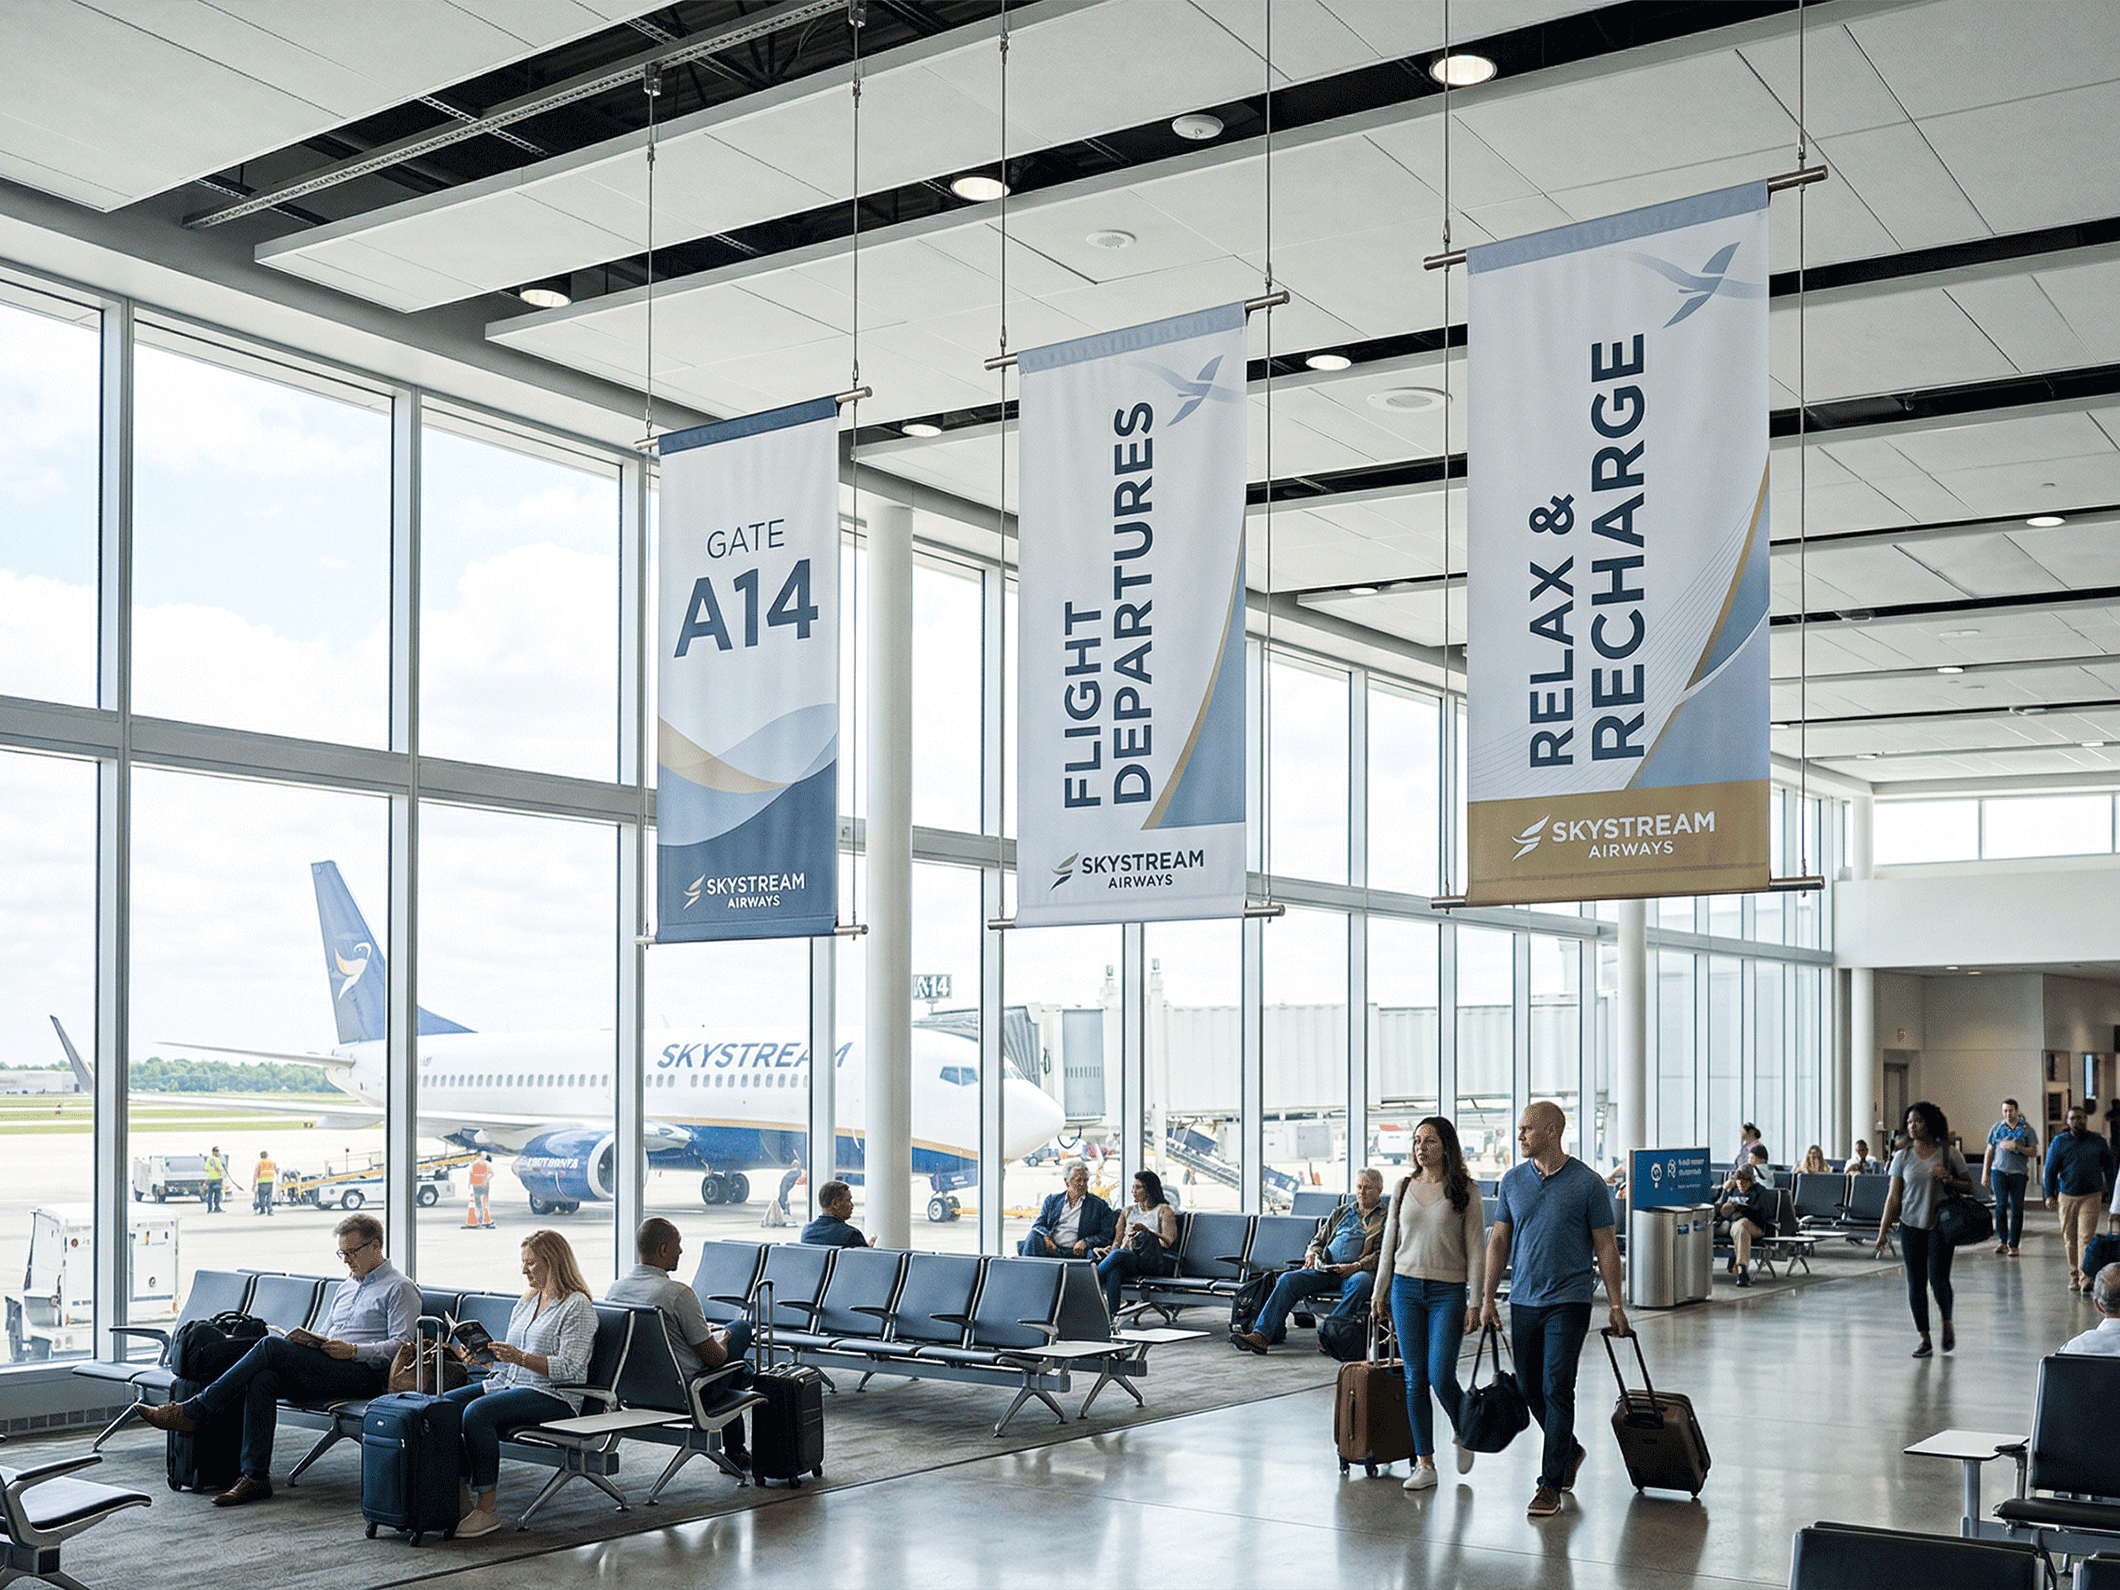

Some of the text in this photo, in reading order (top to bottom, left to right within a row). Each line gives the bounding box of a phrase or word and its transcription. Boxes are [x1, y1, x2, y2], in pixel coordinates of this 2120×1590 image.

[707, 518, 785, 559] GATE
[1590, 333, 1646, 761] RECHARGE
[674, 558, 819, 658] A14
[1113, 402, 1154, 805] DEPARTURES
[1529, 493, 1575, 768] RELAX &
[1064, 602, 1102, 808] FLIGHT
[1552, 811, 1716, 842] SKYSTREAM
[1081, 849, 1204, 874] SKYSTREAM
[1588, 840, 1674, 859] AIRWAYS
[706, 872, 805, 895] SKYSTREAM
[1108, 873, 1173, 889] AIRWAYS
[727, 894, 781, 909] AIRWAYS
